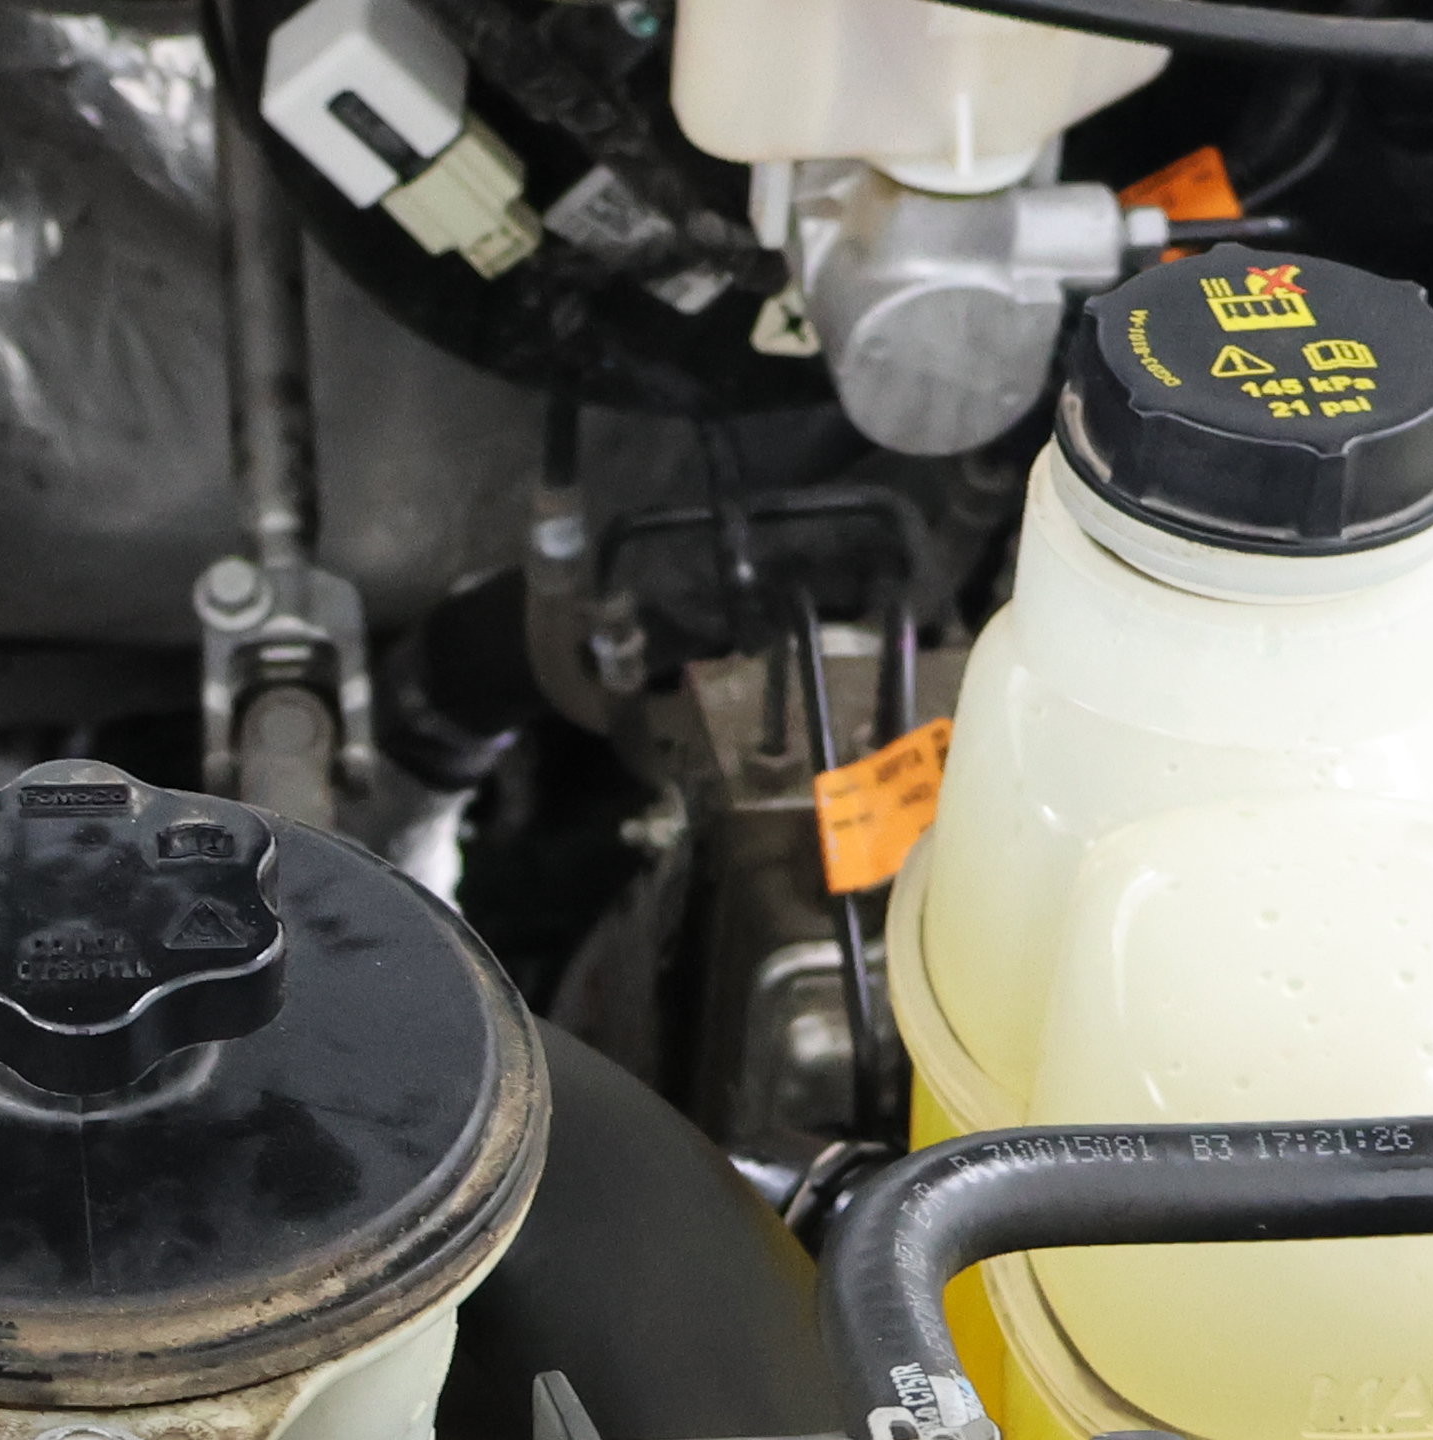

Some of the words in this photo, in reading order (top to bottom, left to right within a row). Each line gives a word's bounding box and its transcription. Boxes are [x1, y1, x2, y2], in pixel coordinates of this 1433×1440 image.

[1240, 377, 1305, 398] 145
[1307, 375, 1377, 394] kPa
[1267, 398, 1311, 418] 21
[1319, 395, 1373, 418] psi
[1189, 1133, 1233, 1162] B3
[1255, 1124, 1415, 1160] 17:21:26
